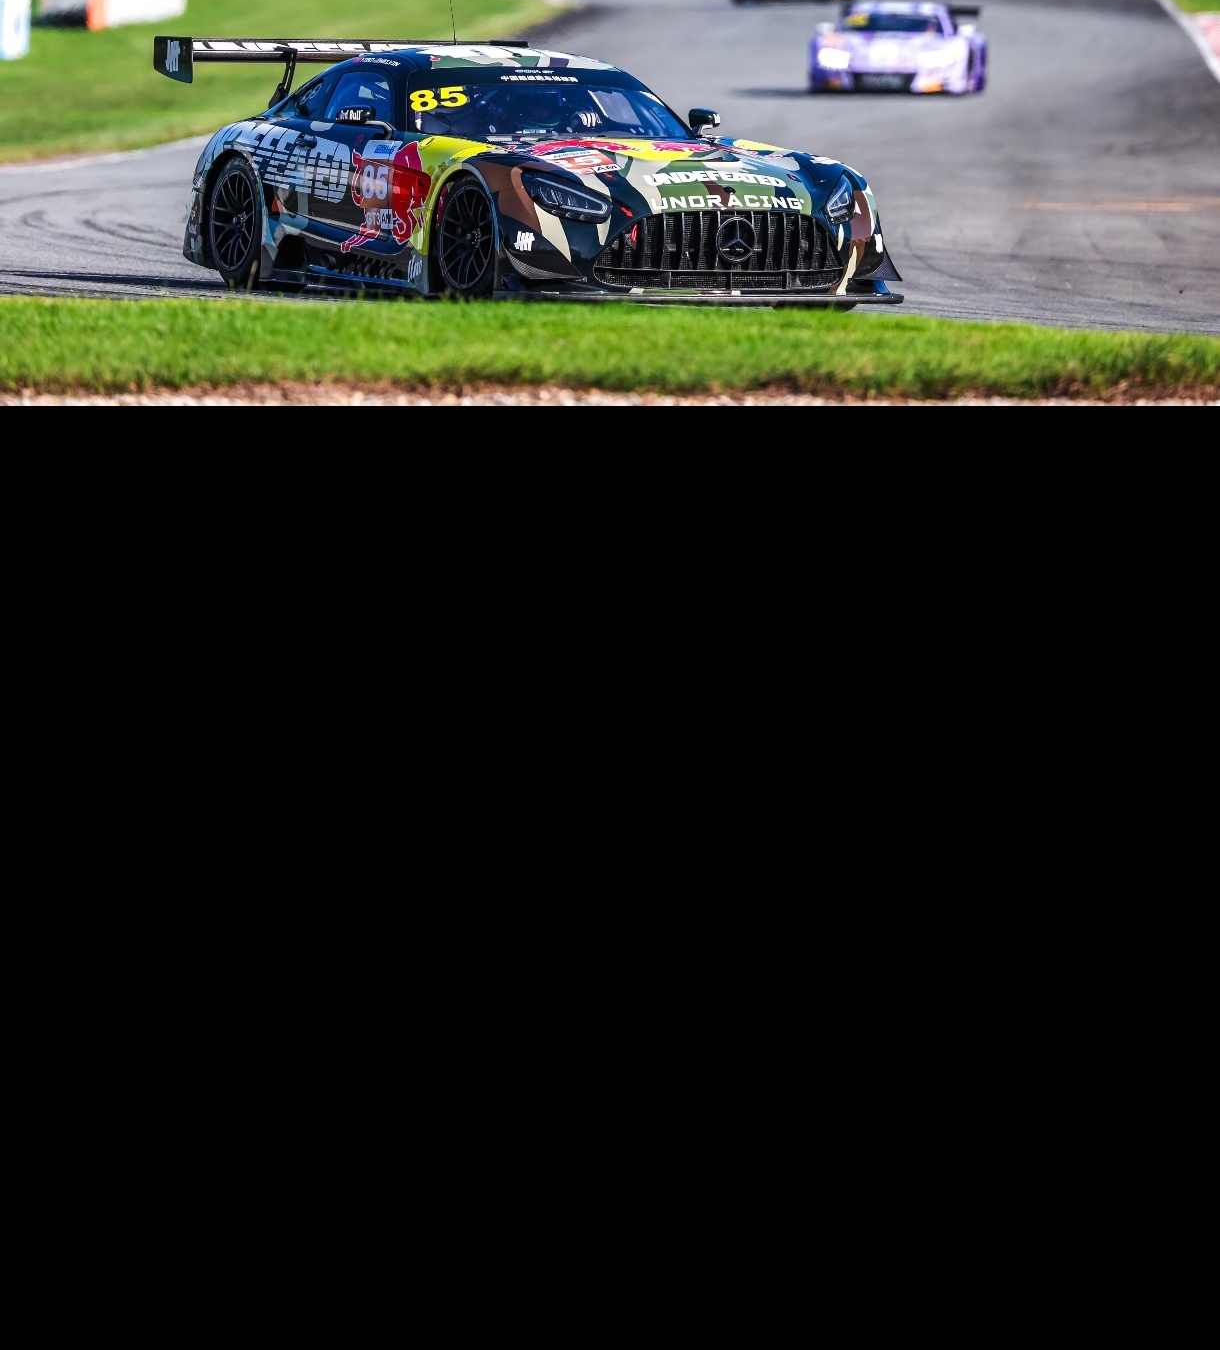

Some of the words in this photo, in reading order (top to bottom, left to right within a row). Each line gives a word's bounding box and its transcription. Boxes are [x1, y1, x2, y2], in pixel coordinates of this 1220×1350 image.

[409, 86, 468, 112] 85
[362, 164, 389, 200] 85
[642, 170, 787, 188] UNDEFEATED
[650, 192, 803, 210] UNORACING
[366, 211, 380, 226] GT3
